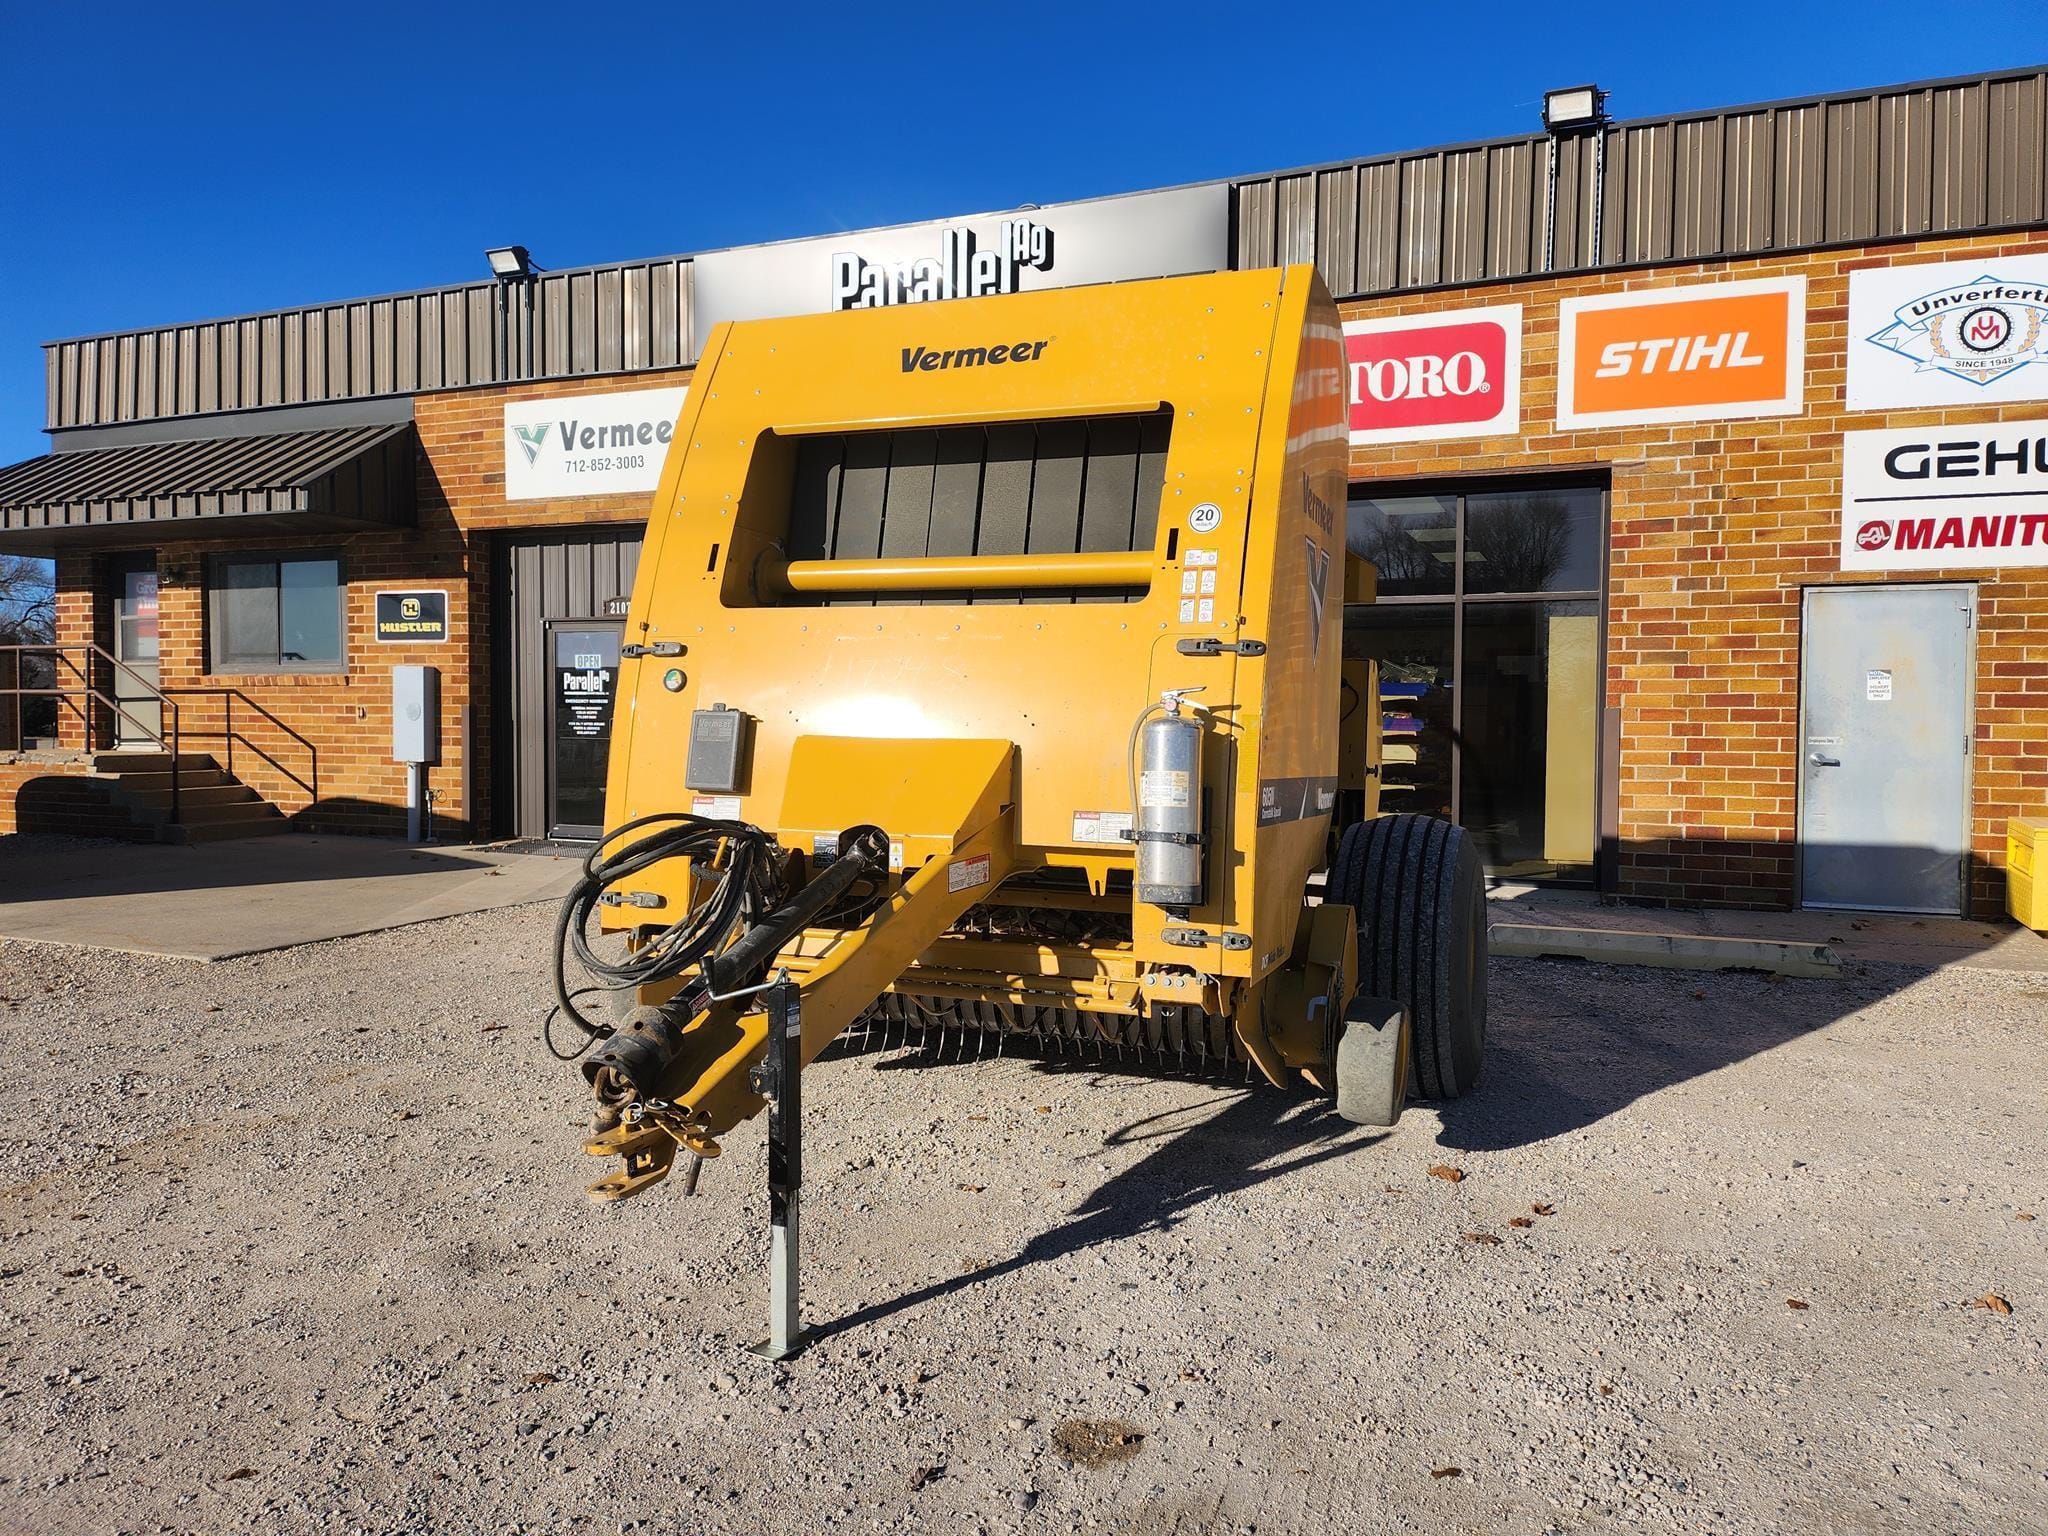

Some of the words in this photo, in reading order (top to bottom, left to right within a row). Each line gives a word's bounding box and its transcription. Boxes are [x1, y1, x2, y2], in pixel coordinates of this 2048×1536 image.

[832, 221, 1019, 312] Parallel
[901, 340, 1048, 373] Vermeer
[1595, 331, 1764, 378] STIHL
[1955, 360, 1987, 368] SINCE
[1990, 357, 2015, 367] 1948
[1350, 351, 1486, 405] TORO
[559, 420, 678, 451] Vermee
[565, 455, 645, 473] 712-852-3003
[1196, 509, 1214, 521] 20
[1302, 470, 1335, 537] Vermeer
[1894, 515, 2048, 551] MANIT
[380, 622, 442, 633] HUSTLER
[577, 656, 600, 668] OPEN
[563, 670, 603, 692] Parallel
